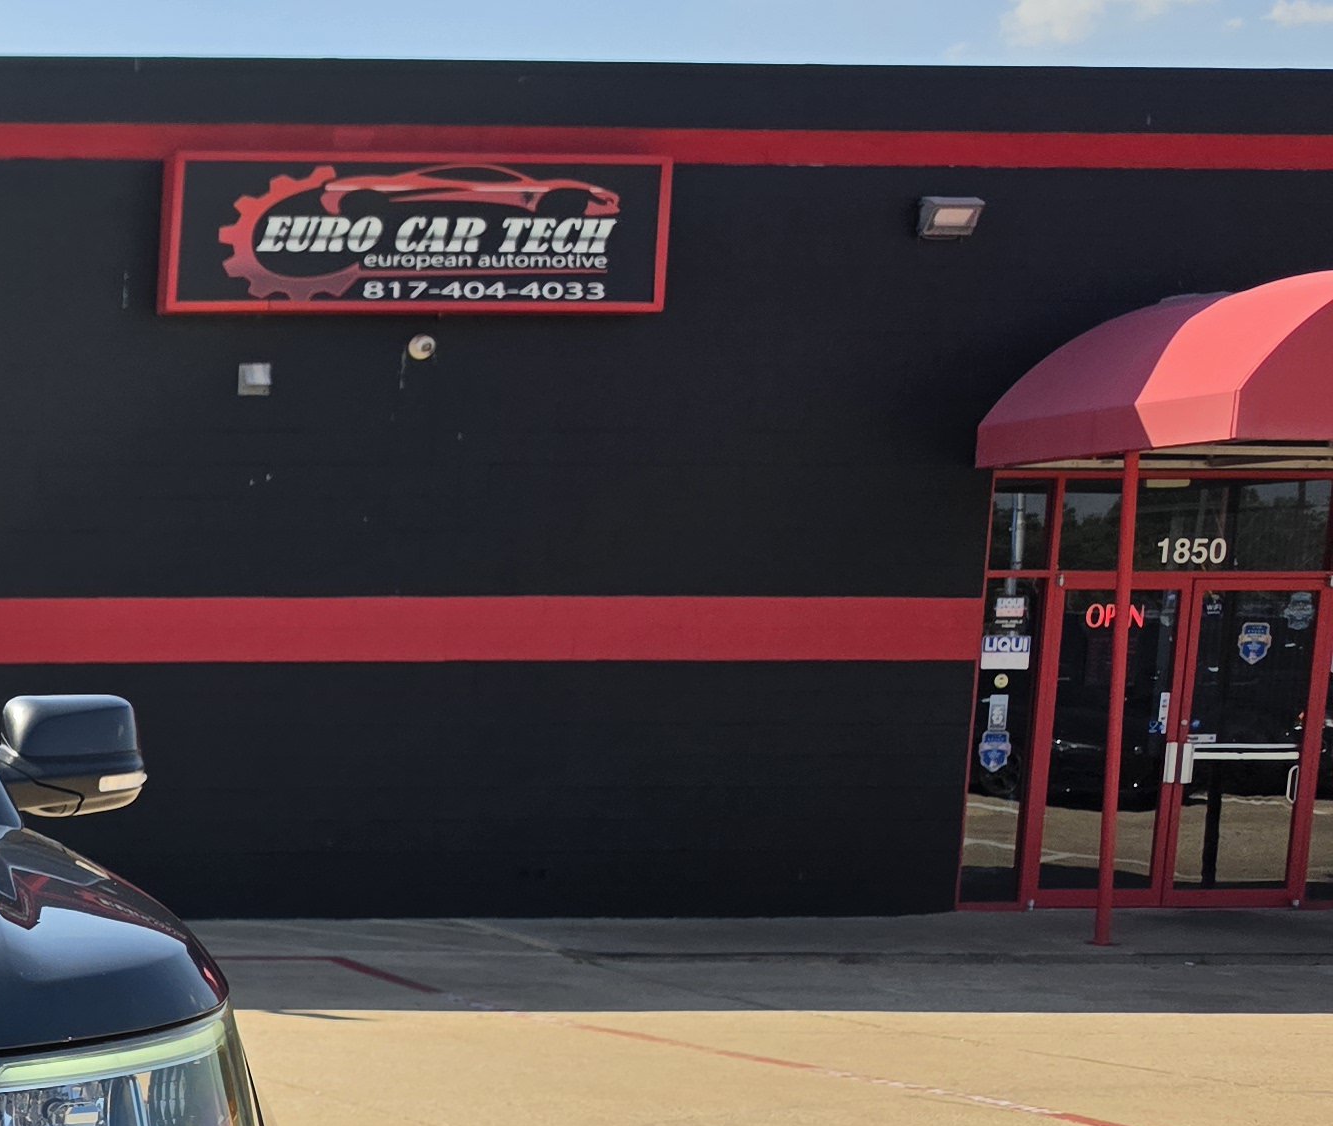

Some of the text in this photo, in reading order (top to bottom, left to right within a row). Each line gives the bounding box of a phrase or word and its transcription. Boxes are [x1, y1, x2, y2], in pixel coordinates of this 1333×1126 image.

[256, 216, 617, 254] EURO CAR TECH
[364, 252, 608, 271] european automotive
[363, 281, 606, 300] 817-404-4033
[1157, 537, 1227, 565] 1850
[1086, 603, 1145, 629] OPN
[984, 636, 1029, 652] LIQUI
